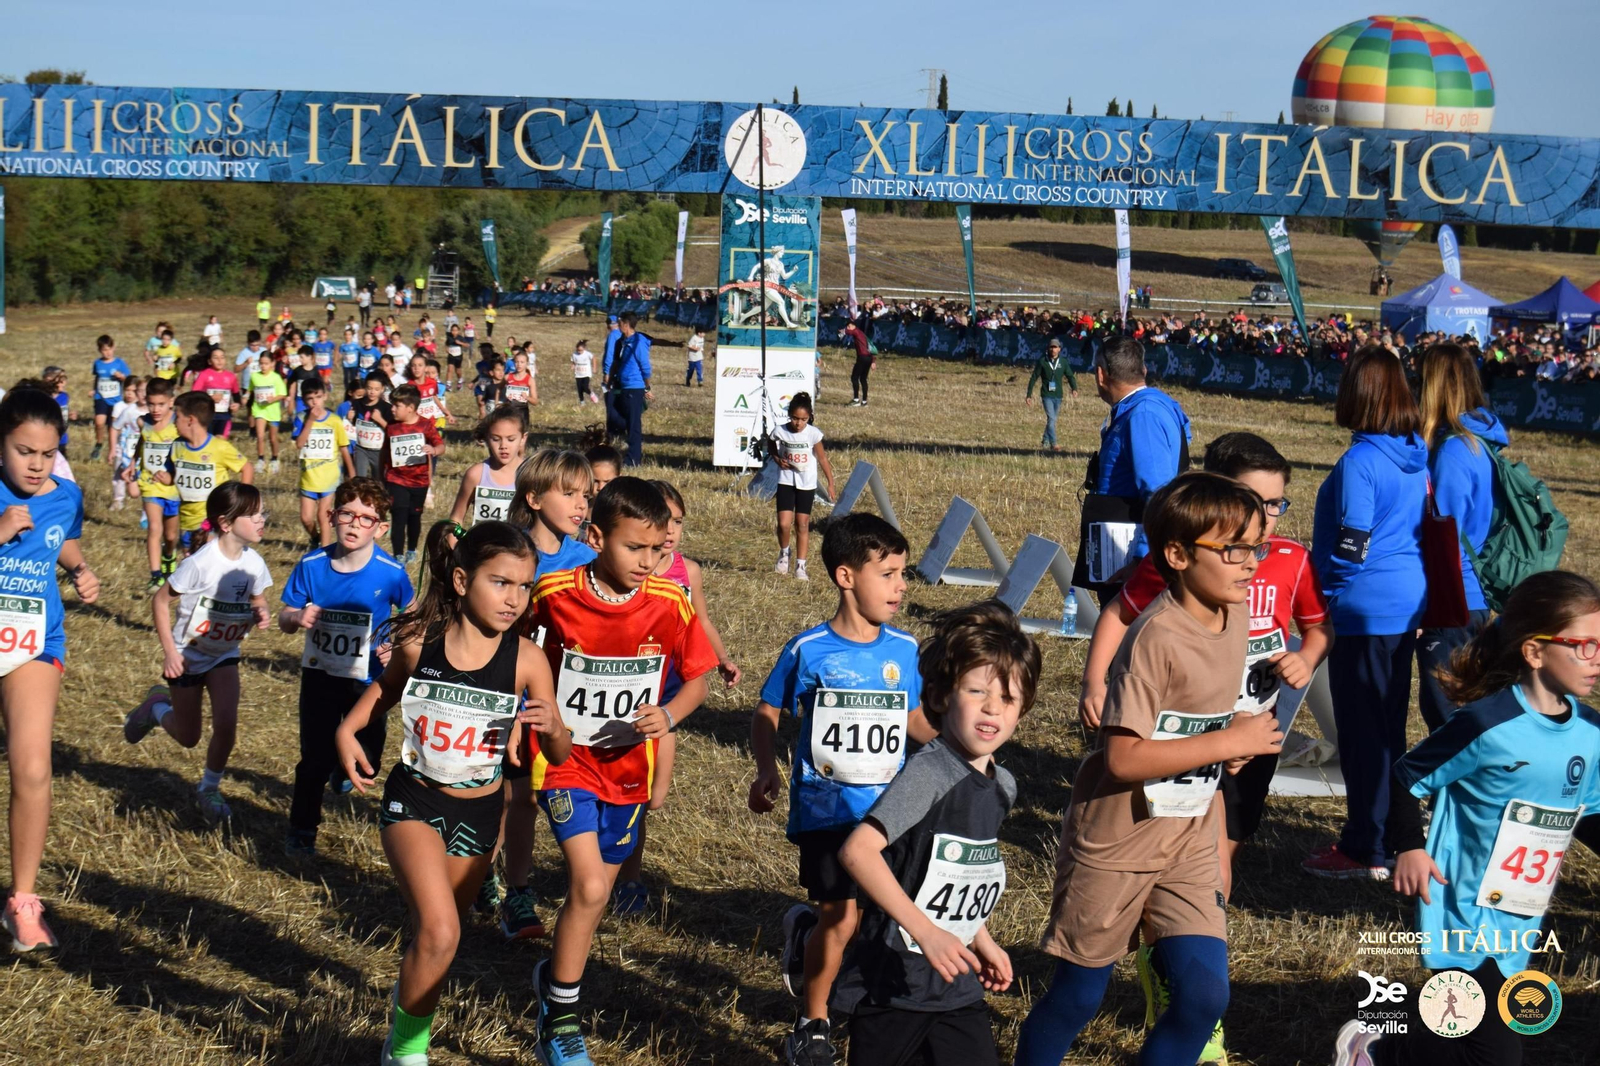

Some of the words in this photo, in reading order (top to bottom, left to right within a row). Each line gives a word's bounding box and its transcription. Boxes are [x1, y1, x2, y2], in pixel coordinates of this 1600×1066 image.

[111, 101, 245, 135] CROSS
[1425, 108, 1455, 130] Hay
[304, 93, 624, 172] ITÁLICA
[112, 138, 293, 158] INTERNACIONAL
[852, 119, 1018, 180] XLIII
[1024, 127, 1153, 163] CROSS
[101, 159, 162, 177] CROSS
[166, 159, 260, 178] COUNTRY
[1023, 162, 1199, 188] INTERNACIONAL
[1212, 125, 1526, 207] ITÁLICA
[850, 177, 1008, 201] INTERNATIONAL
[1012, 183, 1072, 204] CROSS
[1075, 186, 1168, 207] COUNTRY
[782, 214, 817, 224] Sevilla
[1556, 406, 1584, 423] Sevilla
[358, 430, 382, 441] 4473
[395, 444, 423, 456] 4269
[177, 474, 212, 490] 4108
[480, 504, 509, 520] 84
[0, 627, 38, 655] 94
[196, 620, 248, 641] 4502
[312, 629, 363, 658] 4201
[421, 667, 442, 678] 42K
[592, 660, 639, 674] ITÁLICA
[436, 686, 486, 708] ITÁLICA
[566, 687, 651, 718] 4104
[844, 694, 888, 706] ITÁLICA
[412, 714, 499, 758] 4544
[822, 722, 900, 755] 4106
[1540, 812, 1573, 827] ITÁLIC
[968, 846, 998, 861] ITÁLICA
[926, 882, 1001, 922] 4180
